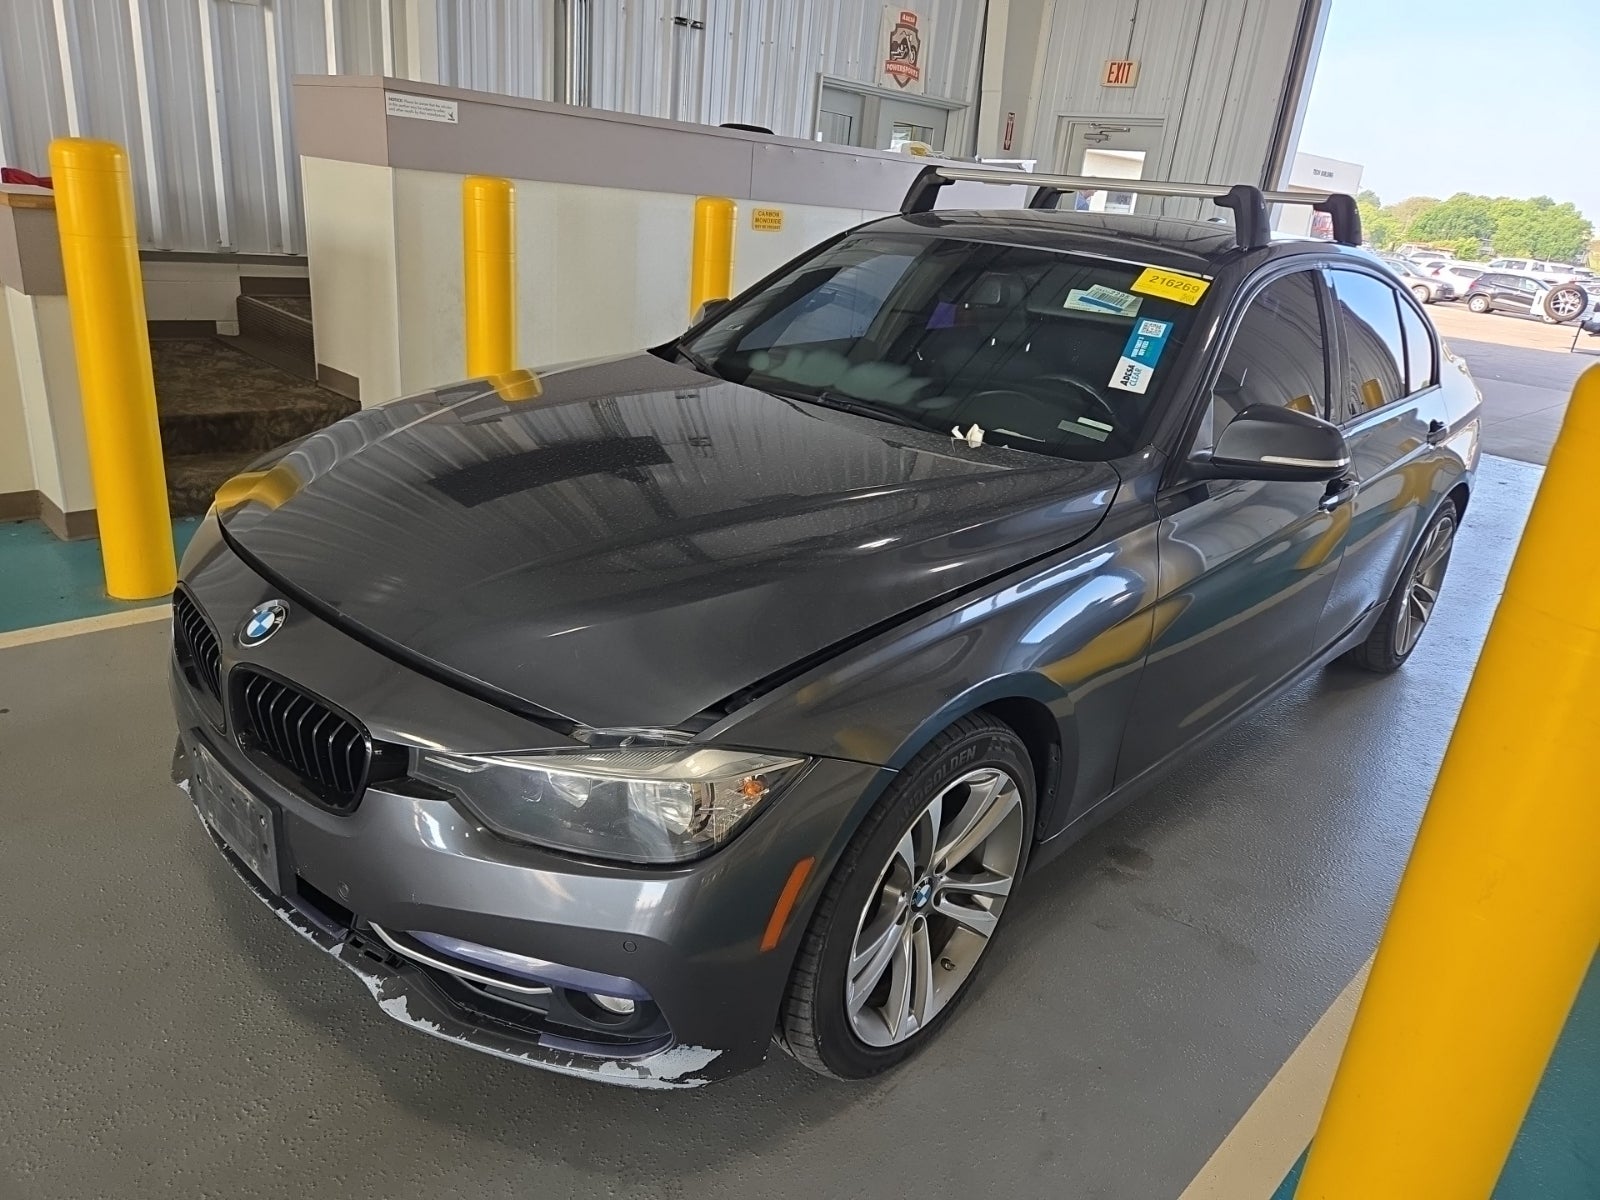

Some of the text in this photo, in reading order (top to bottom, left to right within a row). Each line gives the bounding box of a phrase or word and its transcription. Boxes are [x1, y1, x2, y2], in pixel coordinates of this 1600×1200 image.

[1107, 62, 1133, 84] EXIT
[754, 217, 782, 225] MONOXIDE
[1149, 275, 1200, 294] 216269
[1120, 364, 1136, 387] ADESA
[1129, 367, 1143, 387] CLEAR
